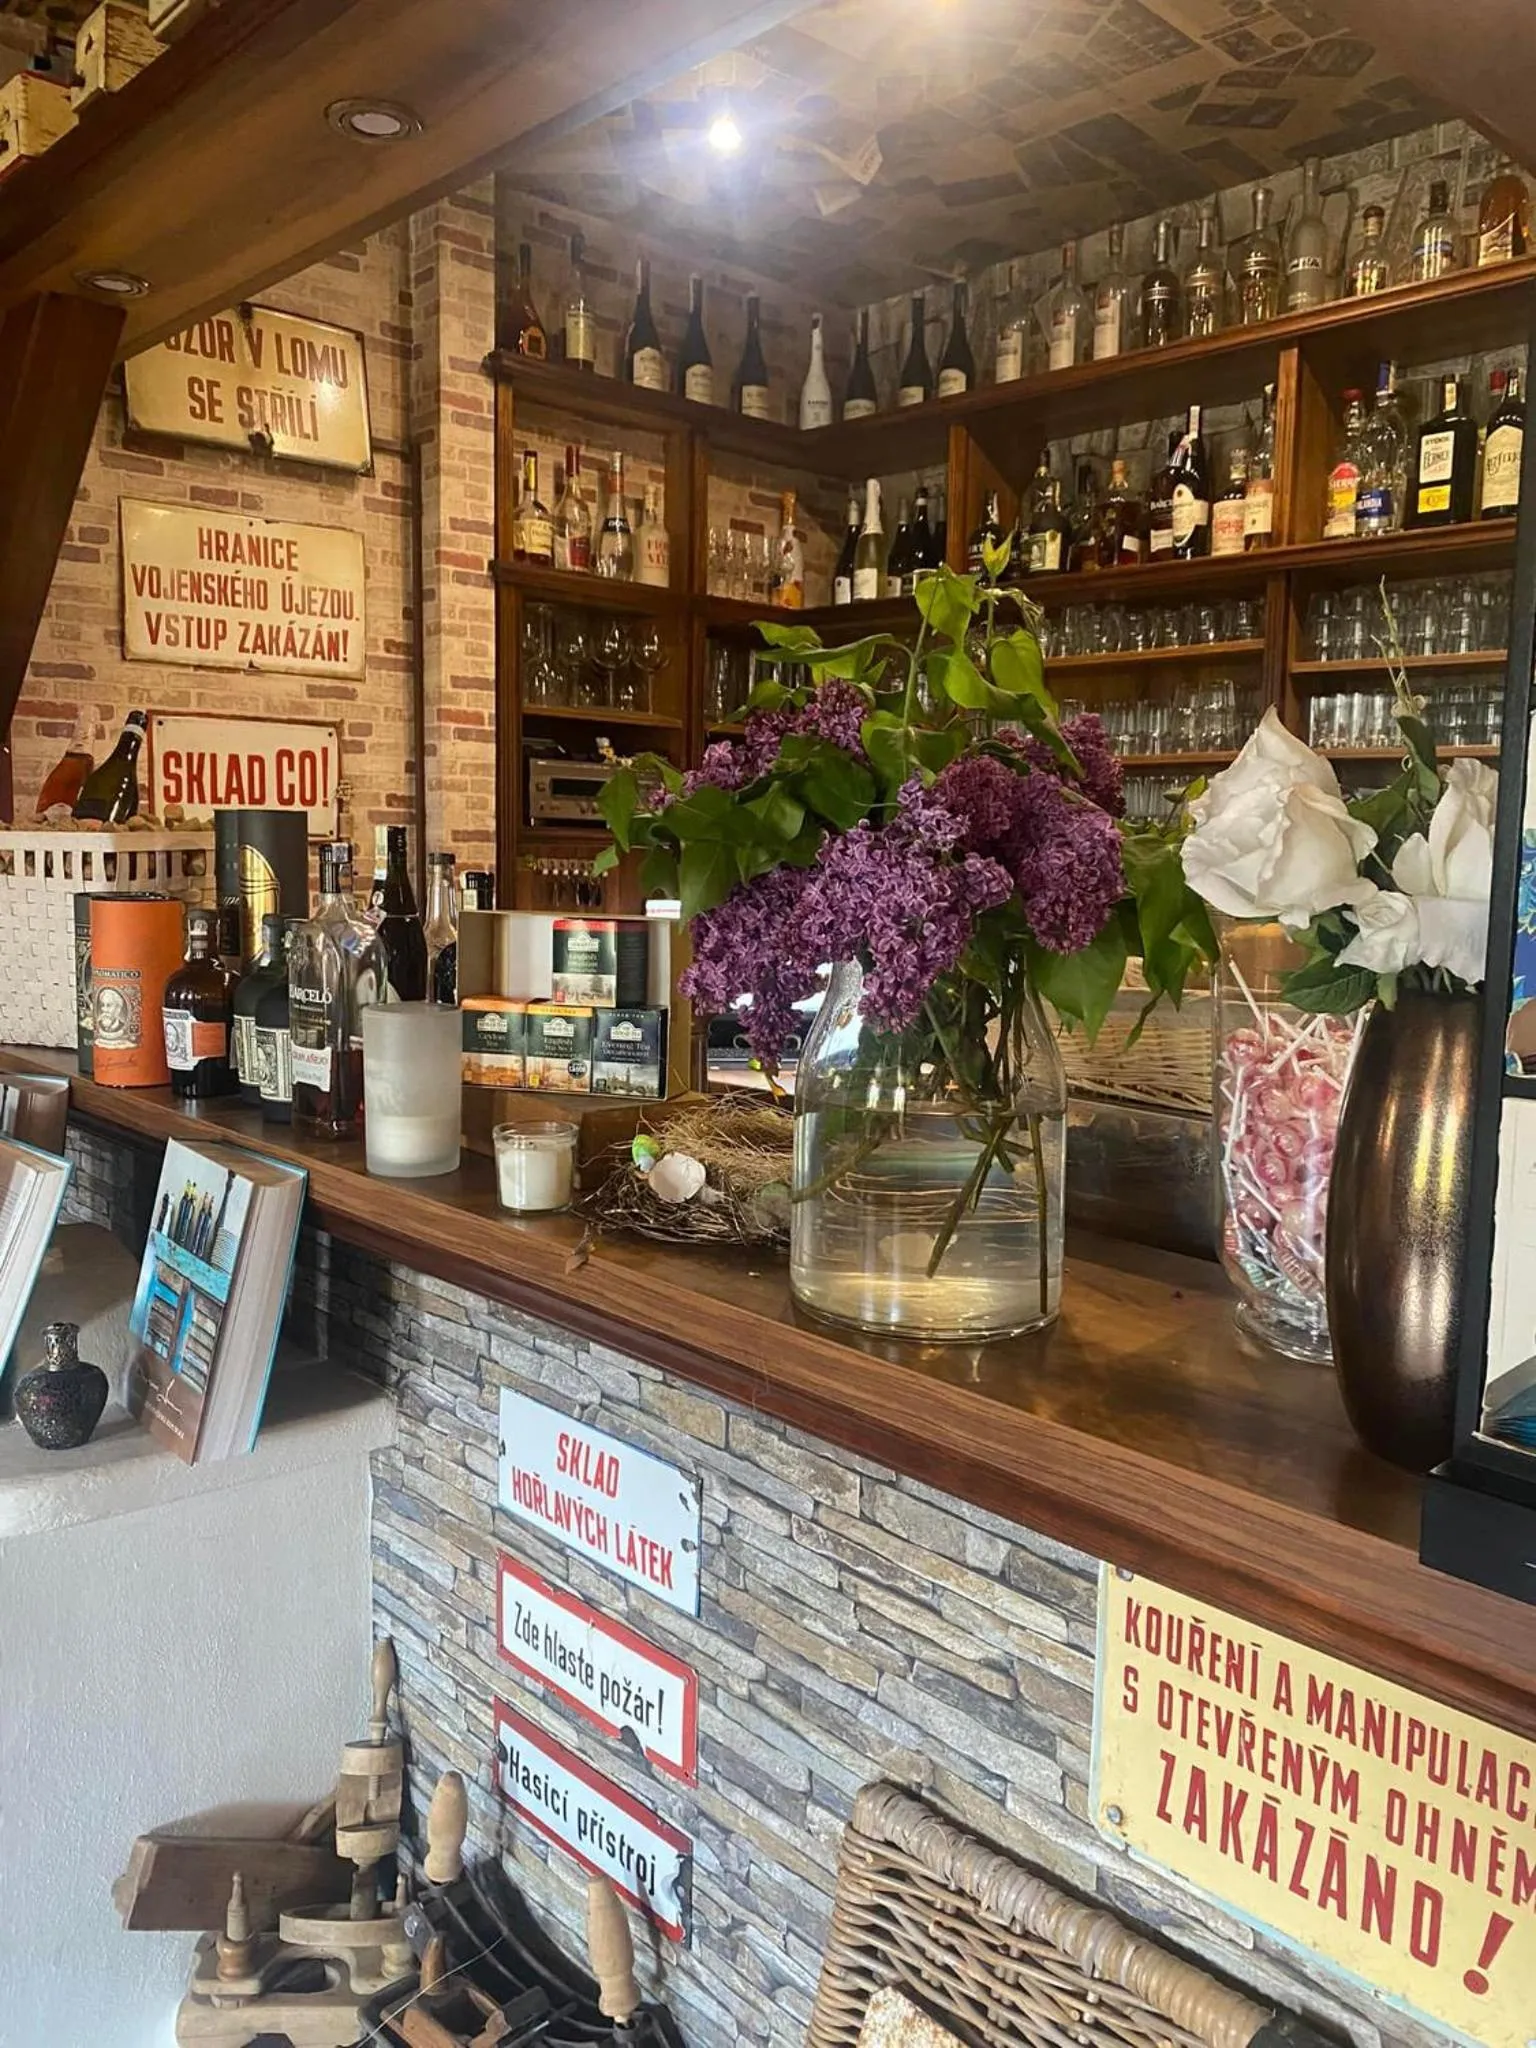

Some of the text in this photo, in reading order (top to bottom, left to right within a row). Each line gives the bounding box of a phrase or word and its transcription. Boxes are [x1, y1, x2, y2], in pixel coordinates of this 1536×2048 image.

[244, 325, 264, 369] V
[275, 332, 349, 389] LOMU
[187, 376, 320, 442] SE STŘÍLÍ
[197, 526, 300, 572] HRANICE
[130, 562, 269, 611] VOJENSKÉHO
[144, 610, 350, 663] VSTUP ZAKÁZÁN!
[162, 746, 330, 808] SKLAD CO!
[556, 1432, 620, 1498] SKLAD
[511, 1465, 674, 1590] HOŘLAVÝCH LÁTEK
[514, 1601, 664, 1735] Zde hlaste požár!
[1123, 1664, 1139, 1714] S
[1156, 1680, 1360, 1825] OTEVŘENÝM
[1124, 1597, 1536, 1829] KOUŘENÍ A MANIPULAC
[576, 1804, 657, 1897] přístroj
[1155, 1748, 1445, 1968] ZAKÁZÁNO
